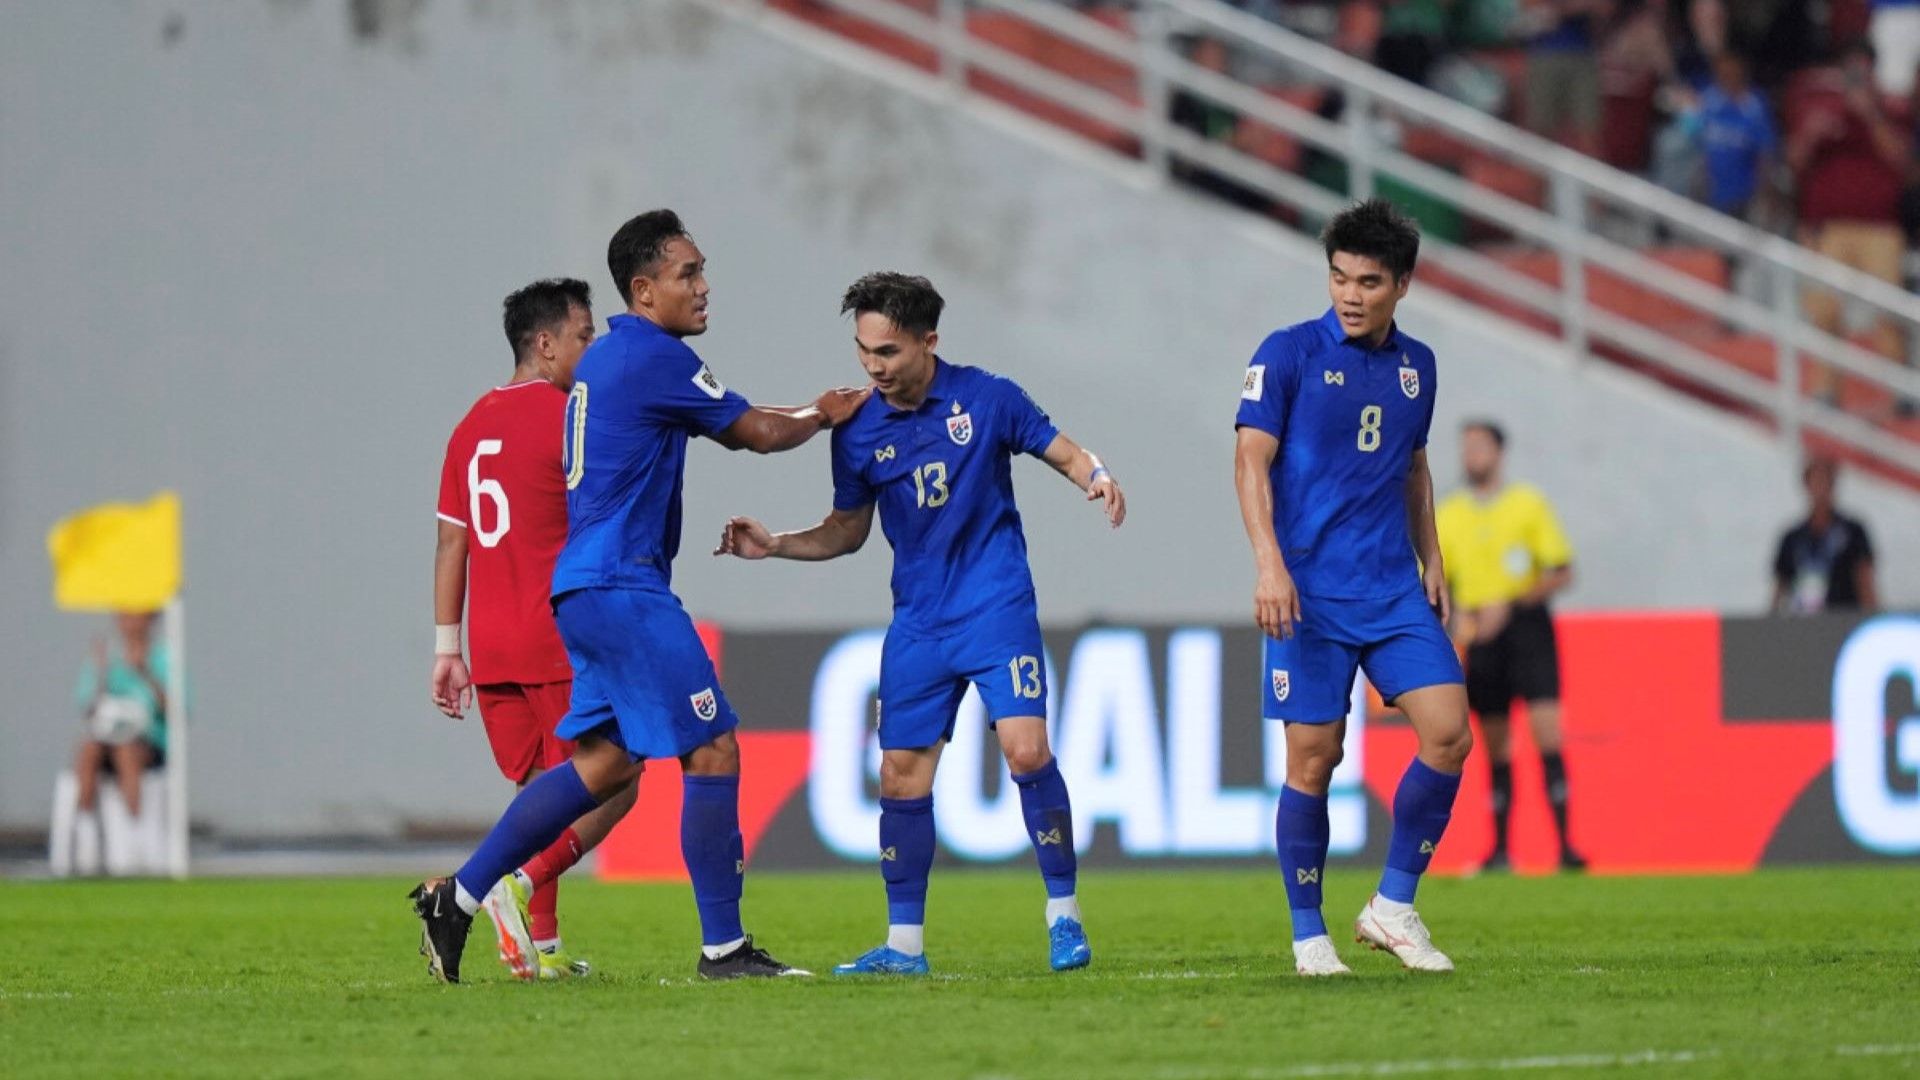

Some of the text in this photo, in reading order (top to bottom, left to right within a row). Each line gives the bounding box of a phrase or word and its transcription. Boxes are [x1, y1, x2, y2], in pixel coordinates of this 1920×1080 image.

[1357, 405, 1382, 452] 8
[468, 439, 511, 548] 6
[912, 461, 949, 509] 13
[1008, 655, 1042, 699] 13
